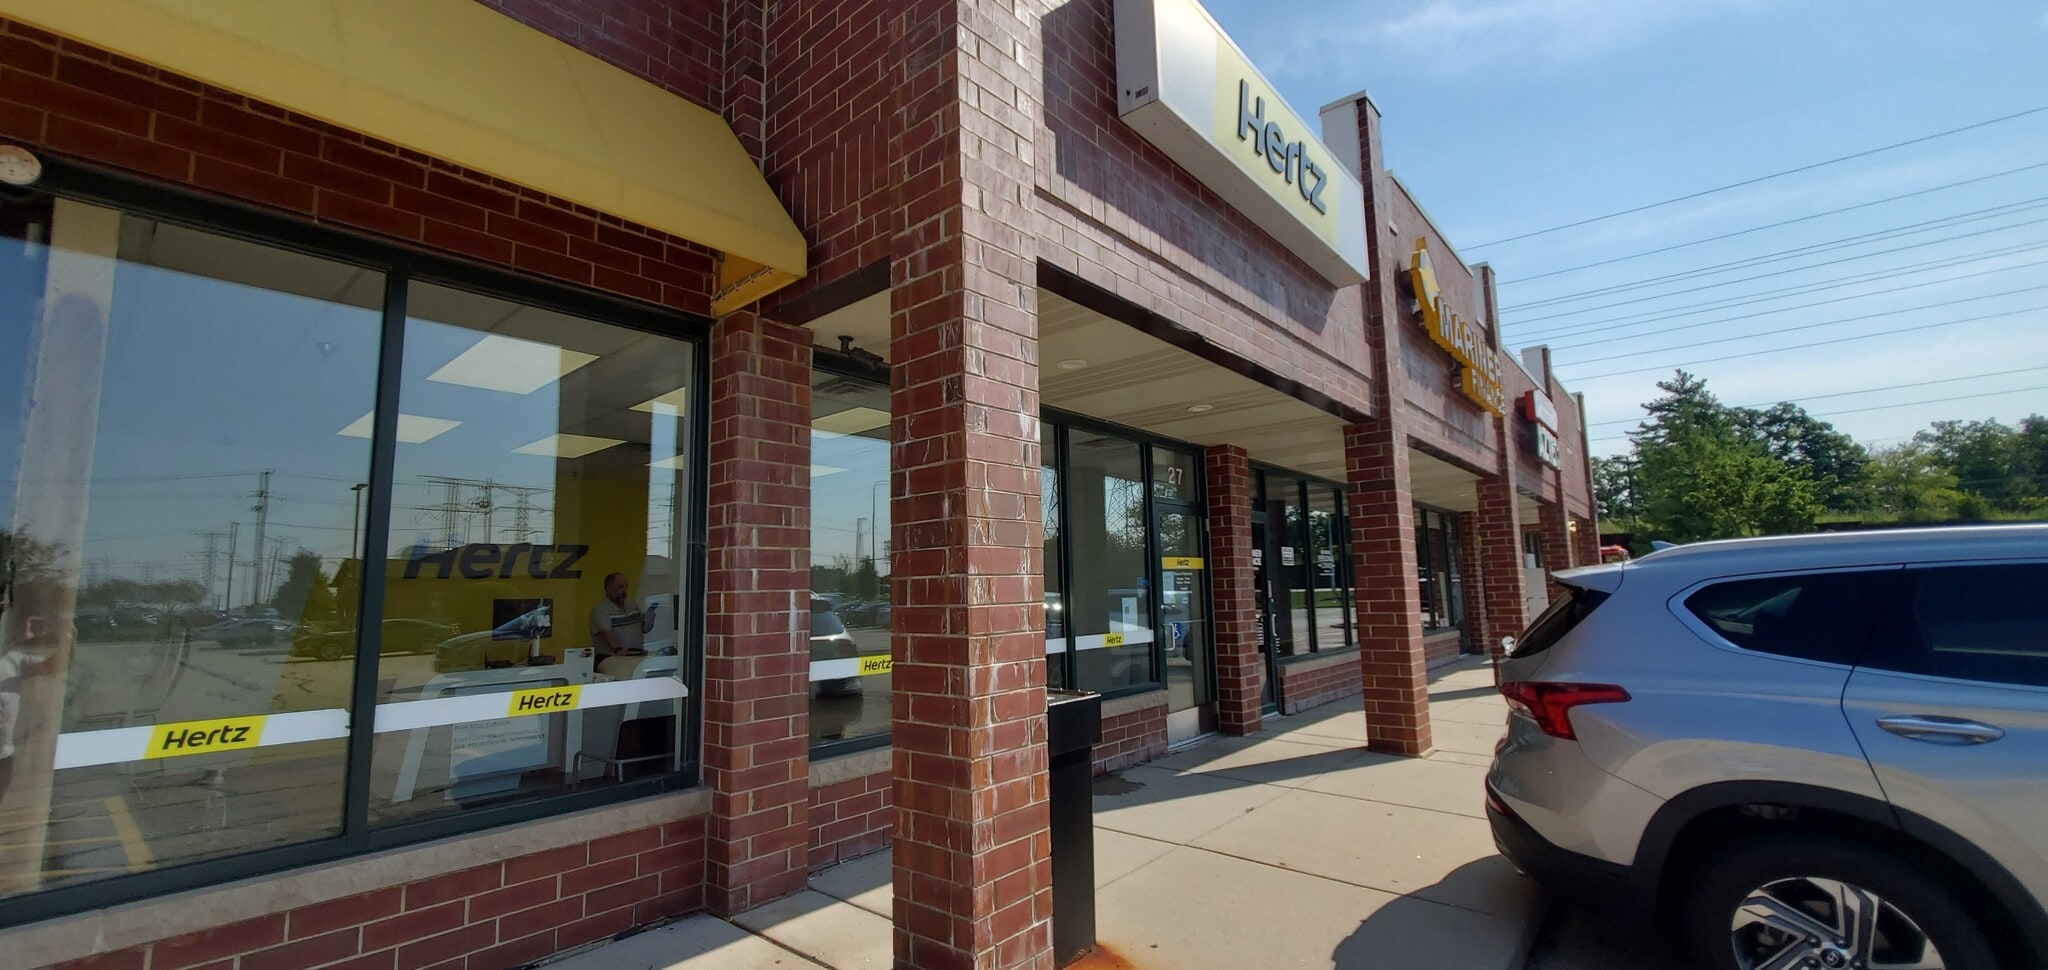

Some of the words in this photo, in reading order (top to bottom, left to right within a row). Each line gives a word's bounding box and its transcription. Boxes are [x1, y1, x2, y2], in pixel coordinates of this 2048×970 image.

[1238, 78, 1328, 215] Hertz
[1167, 466, 1183, 486] 27
[403, 541, 589, 580] Hertz
[1106, 636, 1122, 645] Hertz
[864, 660, 892, 672] Hertz
[518, 692, 573, 711] Hertz
[162, 725, 251, 750] Hertz
